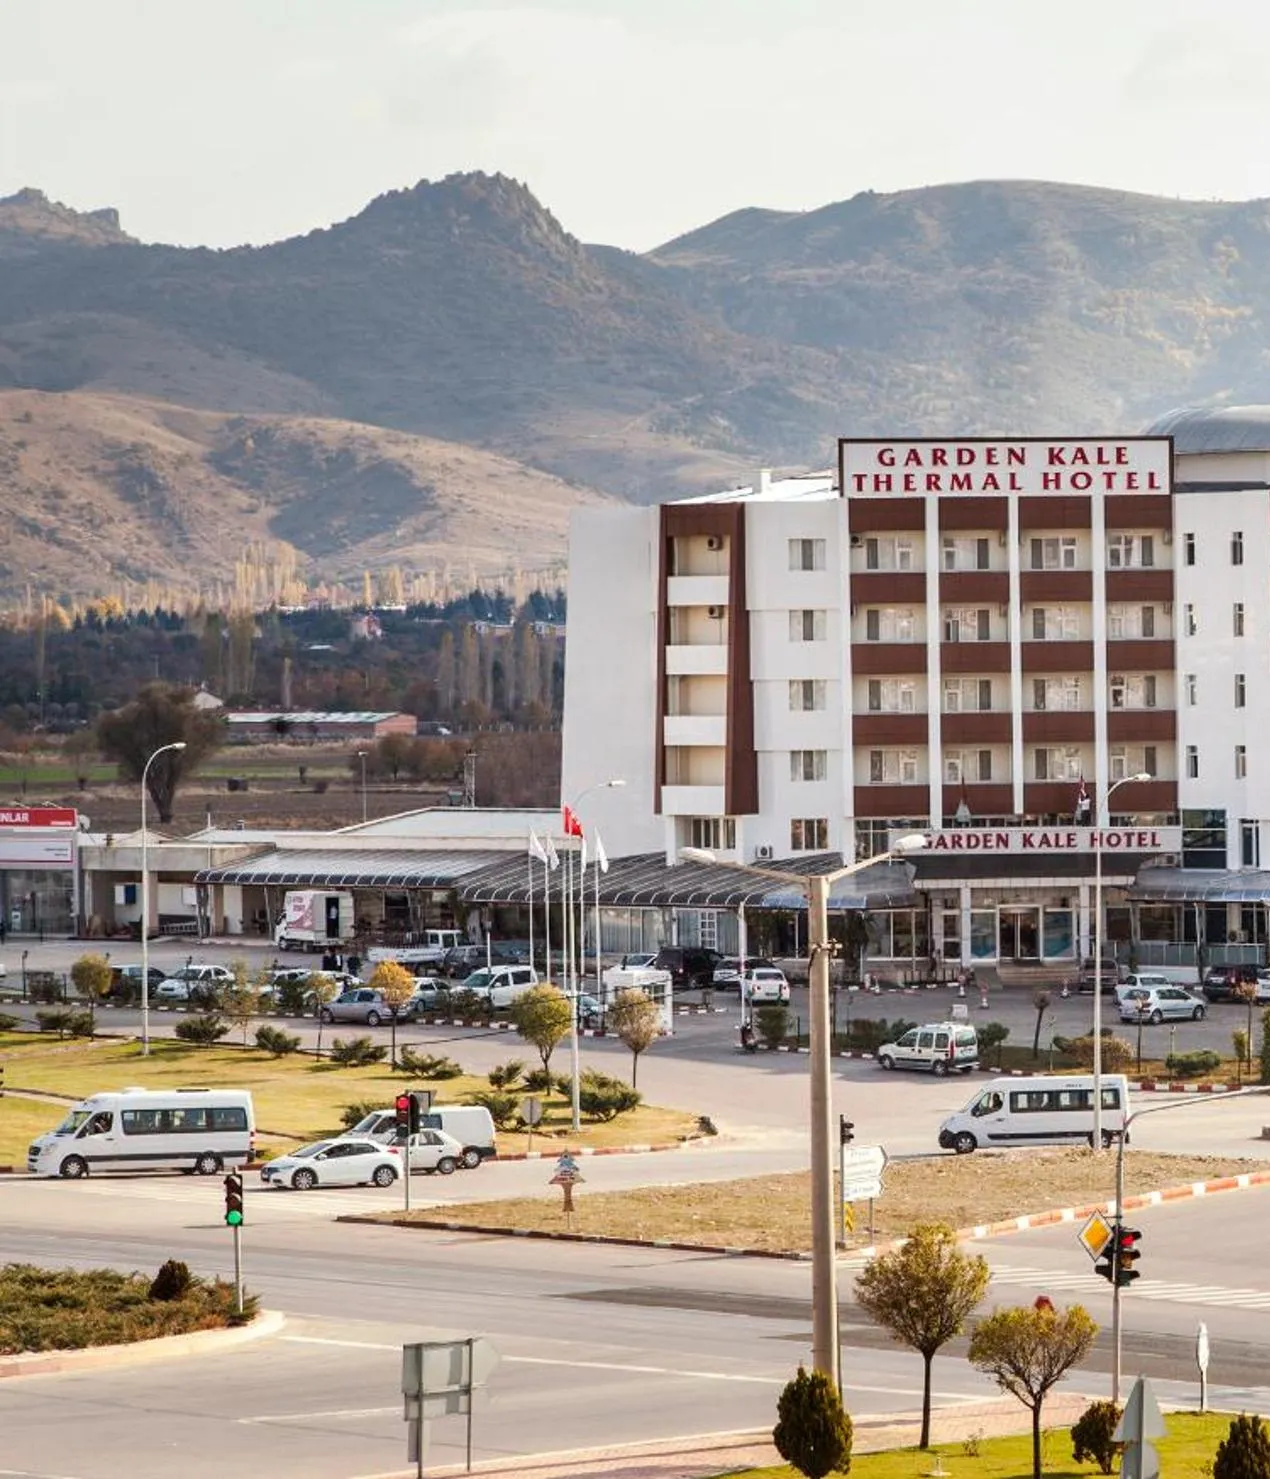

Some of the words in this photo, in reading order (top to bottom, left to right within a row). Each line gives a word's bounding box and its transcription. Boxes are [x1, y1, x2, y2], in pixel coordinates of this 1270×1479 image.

[877, 446, 1026, 467] GARDEN
[1047, 446, 1131, 466] KALE
[851, 472, 1024, 492] THERMAL
[1042, 471, 1161, 491] HOTEL
[1022, 831, 1078, 848] KALE
[1089, 831, 1162, 848] HOTEL
